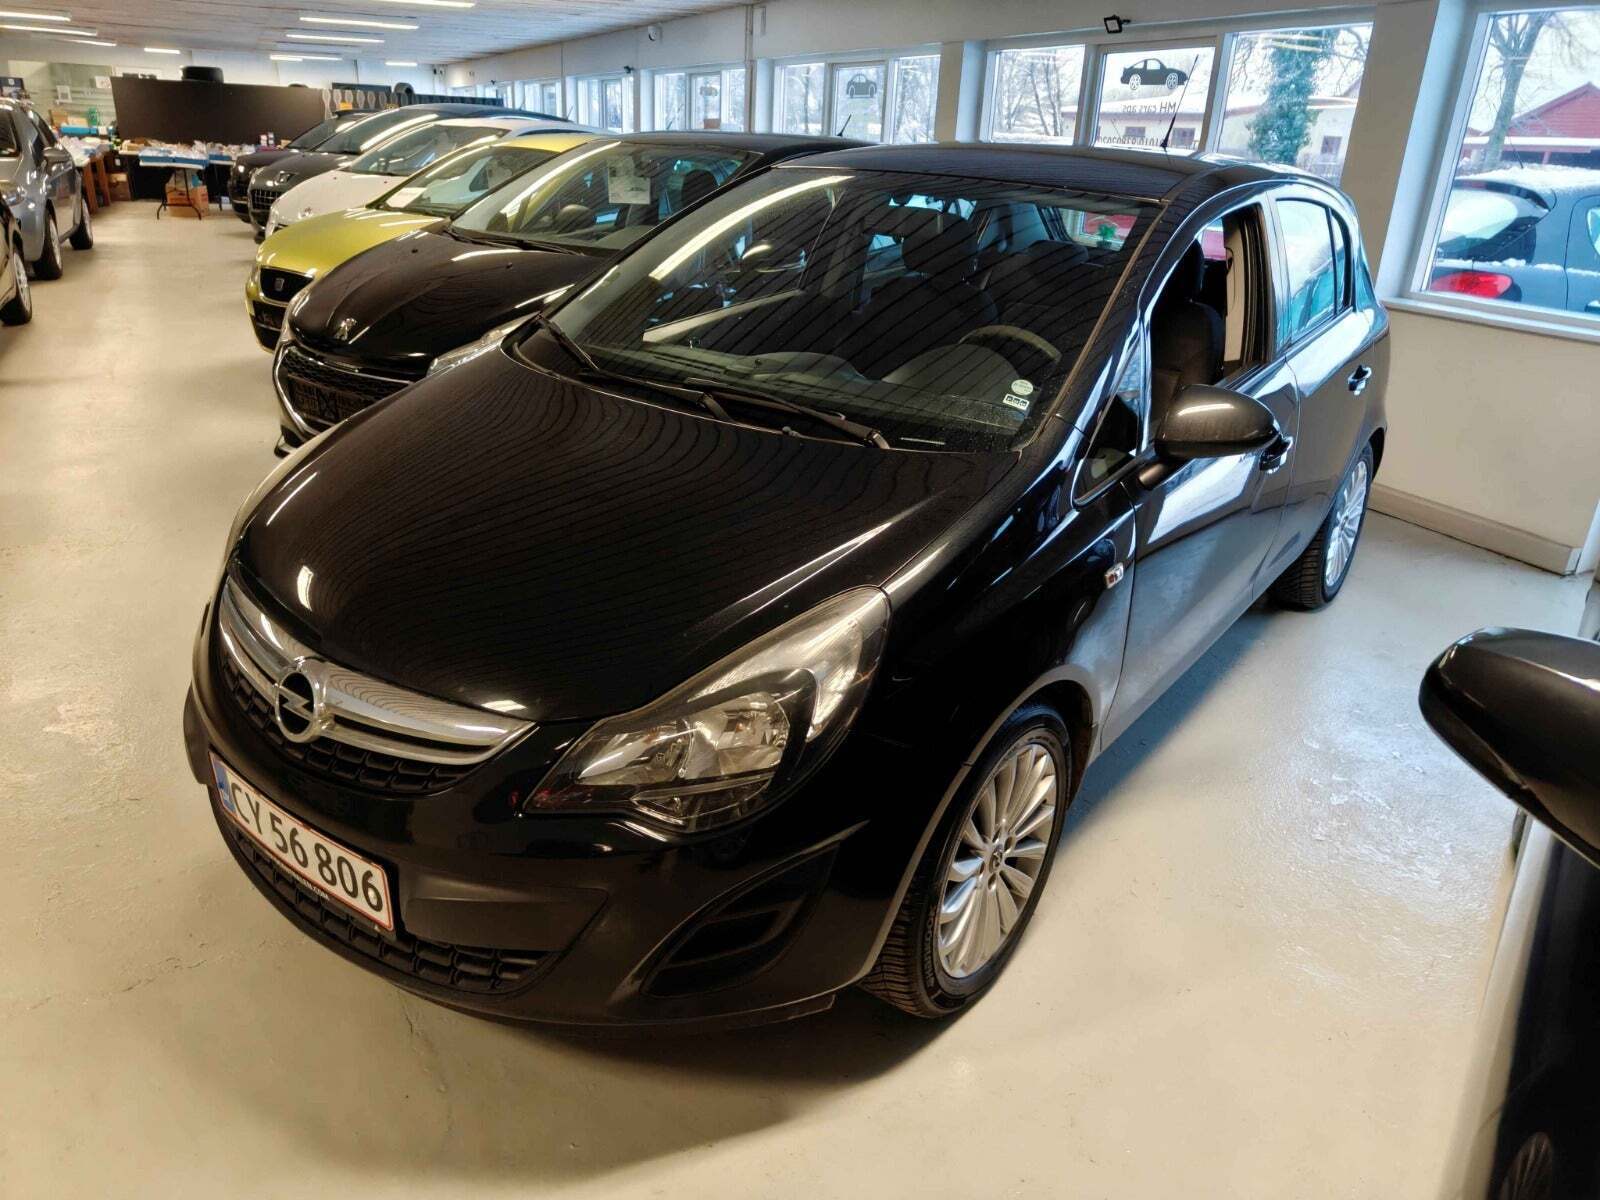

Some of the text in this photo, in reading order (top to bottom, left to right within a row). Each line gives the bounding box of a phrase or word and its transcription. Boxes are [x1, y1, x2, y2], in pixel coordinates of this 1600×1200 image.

[230, 782, 264, 836] CY
[269, 811, 309, 869] 56
[314, 842, 384, 913] 806
